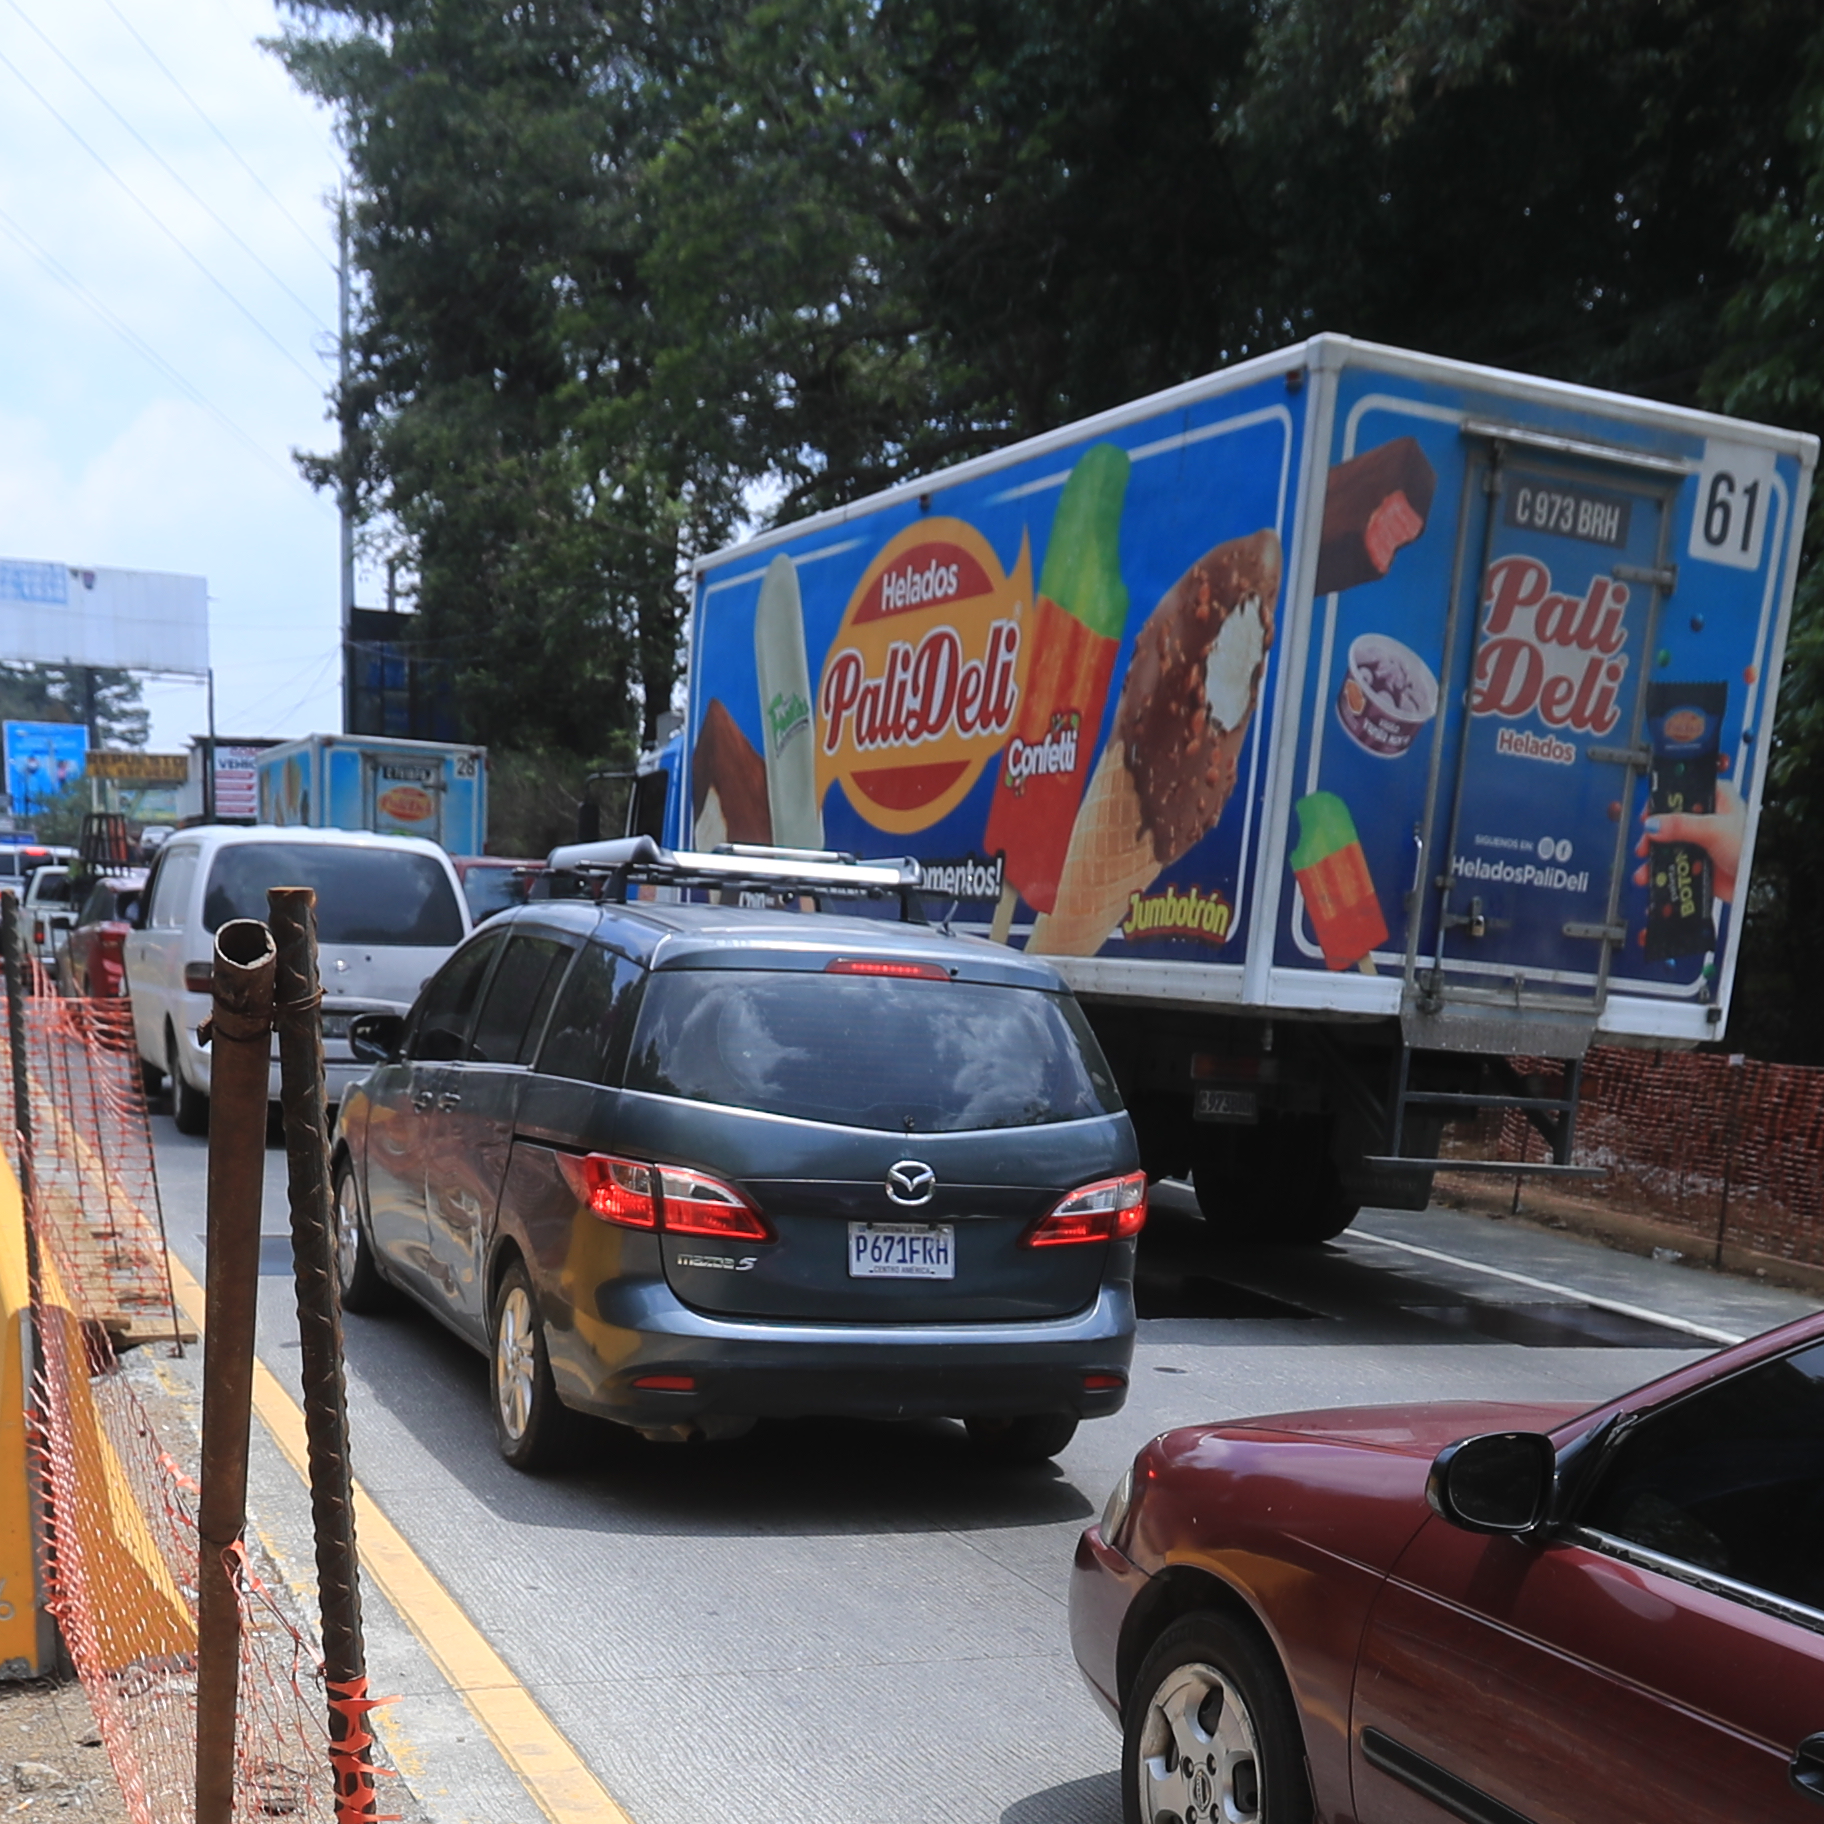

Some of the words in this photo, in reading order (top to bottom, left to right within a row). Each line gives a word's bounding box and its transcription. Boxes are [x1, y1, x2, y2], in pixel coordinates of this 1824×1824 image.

[1515, 487, 1532, 525] C
[1533, 491, 1574, 532] 973
[1577, 498, 1620, 543] BRH
[1703, 470, 1759, 552] 61
[881, 558, 959, 612] Helados
[1484, 556, 1629, 655] Pali
[823, 619, 1019, 756] PaliDeli
[1465, 637, 1626, 736] Deli
[218, 758, 257, 770] VEHIC
[456, 757, 475, 777] 28
[1008, 729, 1078, 776] Confetti
[1497, 728, 1576, 765] Helados
[1451, 855, 1590, 893] HeladosPaliDeli
[1123, 886, 1229, 937] Jumbotrón
